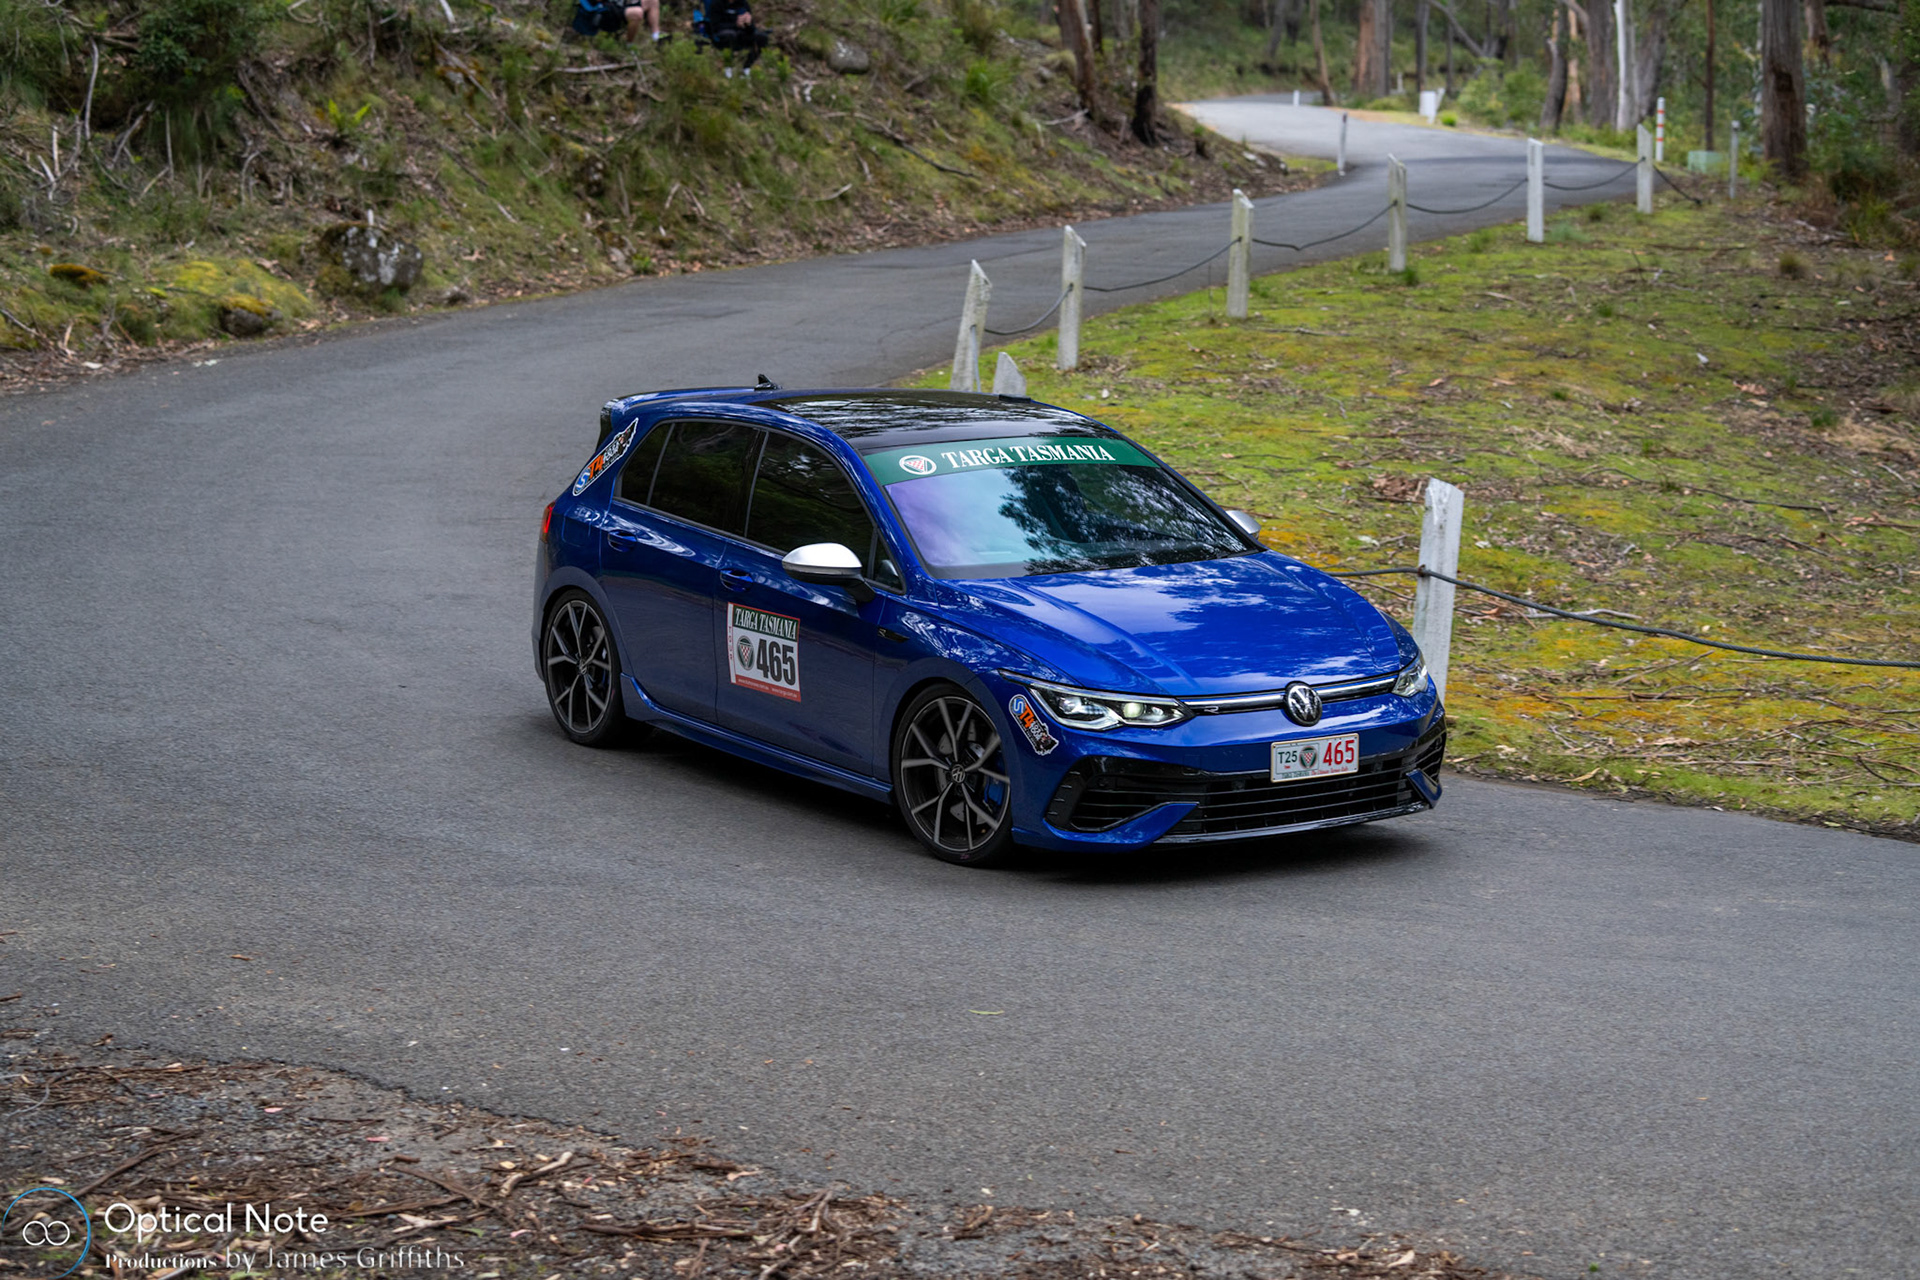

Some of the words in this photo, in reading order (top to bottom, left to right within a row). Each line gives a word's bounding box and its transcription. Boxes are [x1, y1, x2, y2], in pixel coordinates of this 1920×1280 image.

[941, 447, 1010, 469] TARGA
[1009, 445, 1116, 463] TASMANIA
[735, 608, 758, 630] TARGA
[760, 614, 797, 640] TASMANIA
[756, 638, 796, 686] 465
[1278, 750, 1298, 764] T25
[1323, 739, 1355, 766] 465
